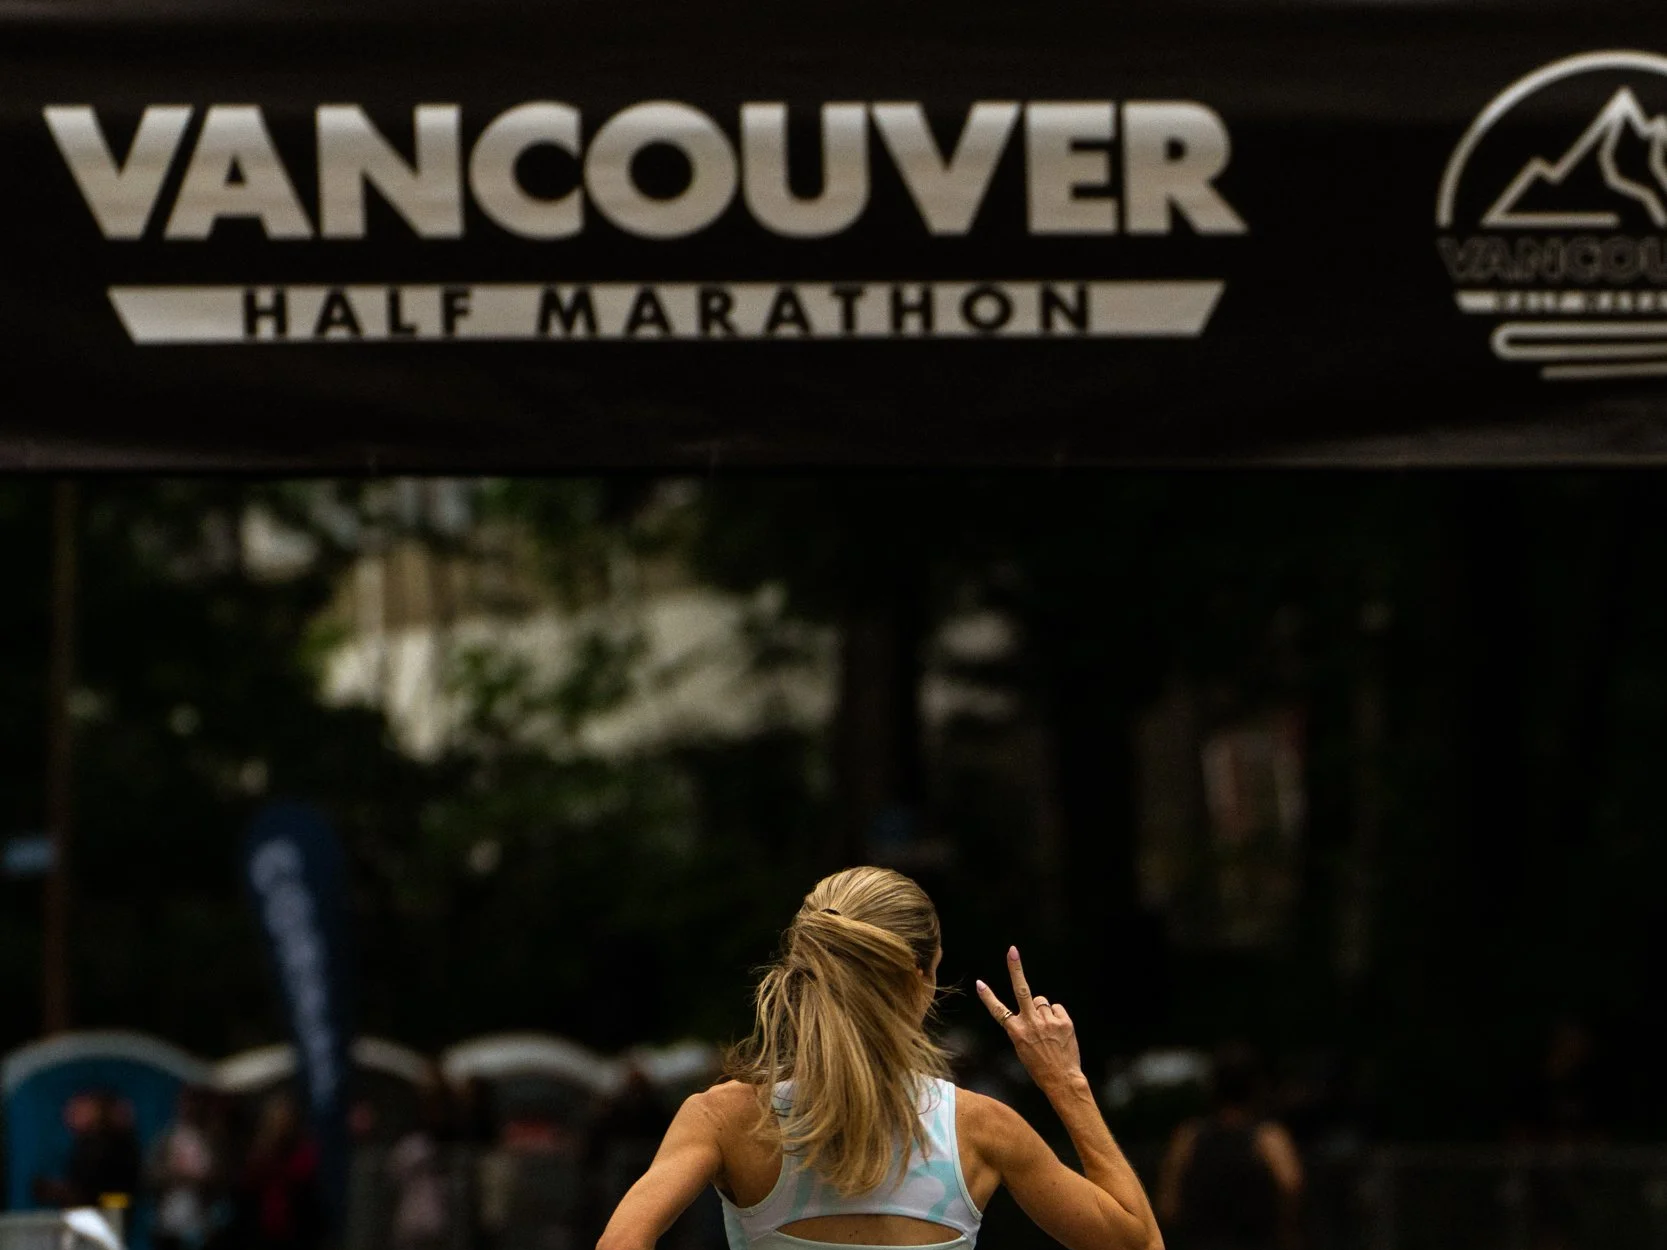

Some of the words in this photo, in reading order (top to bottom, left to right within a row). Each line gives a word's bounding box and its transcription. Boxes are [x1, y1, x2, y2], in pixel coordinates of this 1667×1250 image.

[42, 99, 1250, 241] VANCOUVER
[244, 290, 471, 336] HALF
[538, 286, 1087, 336] MARATHON
